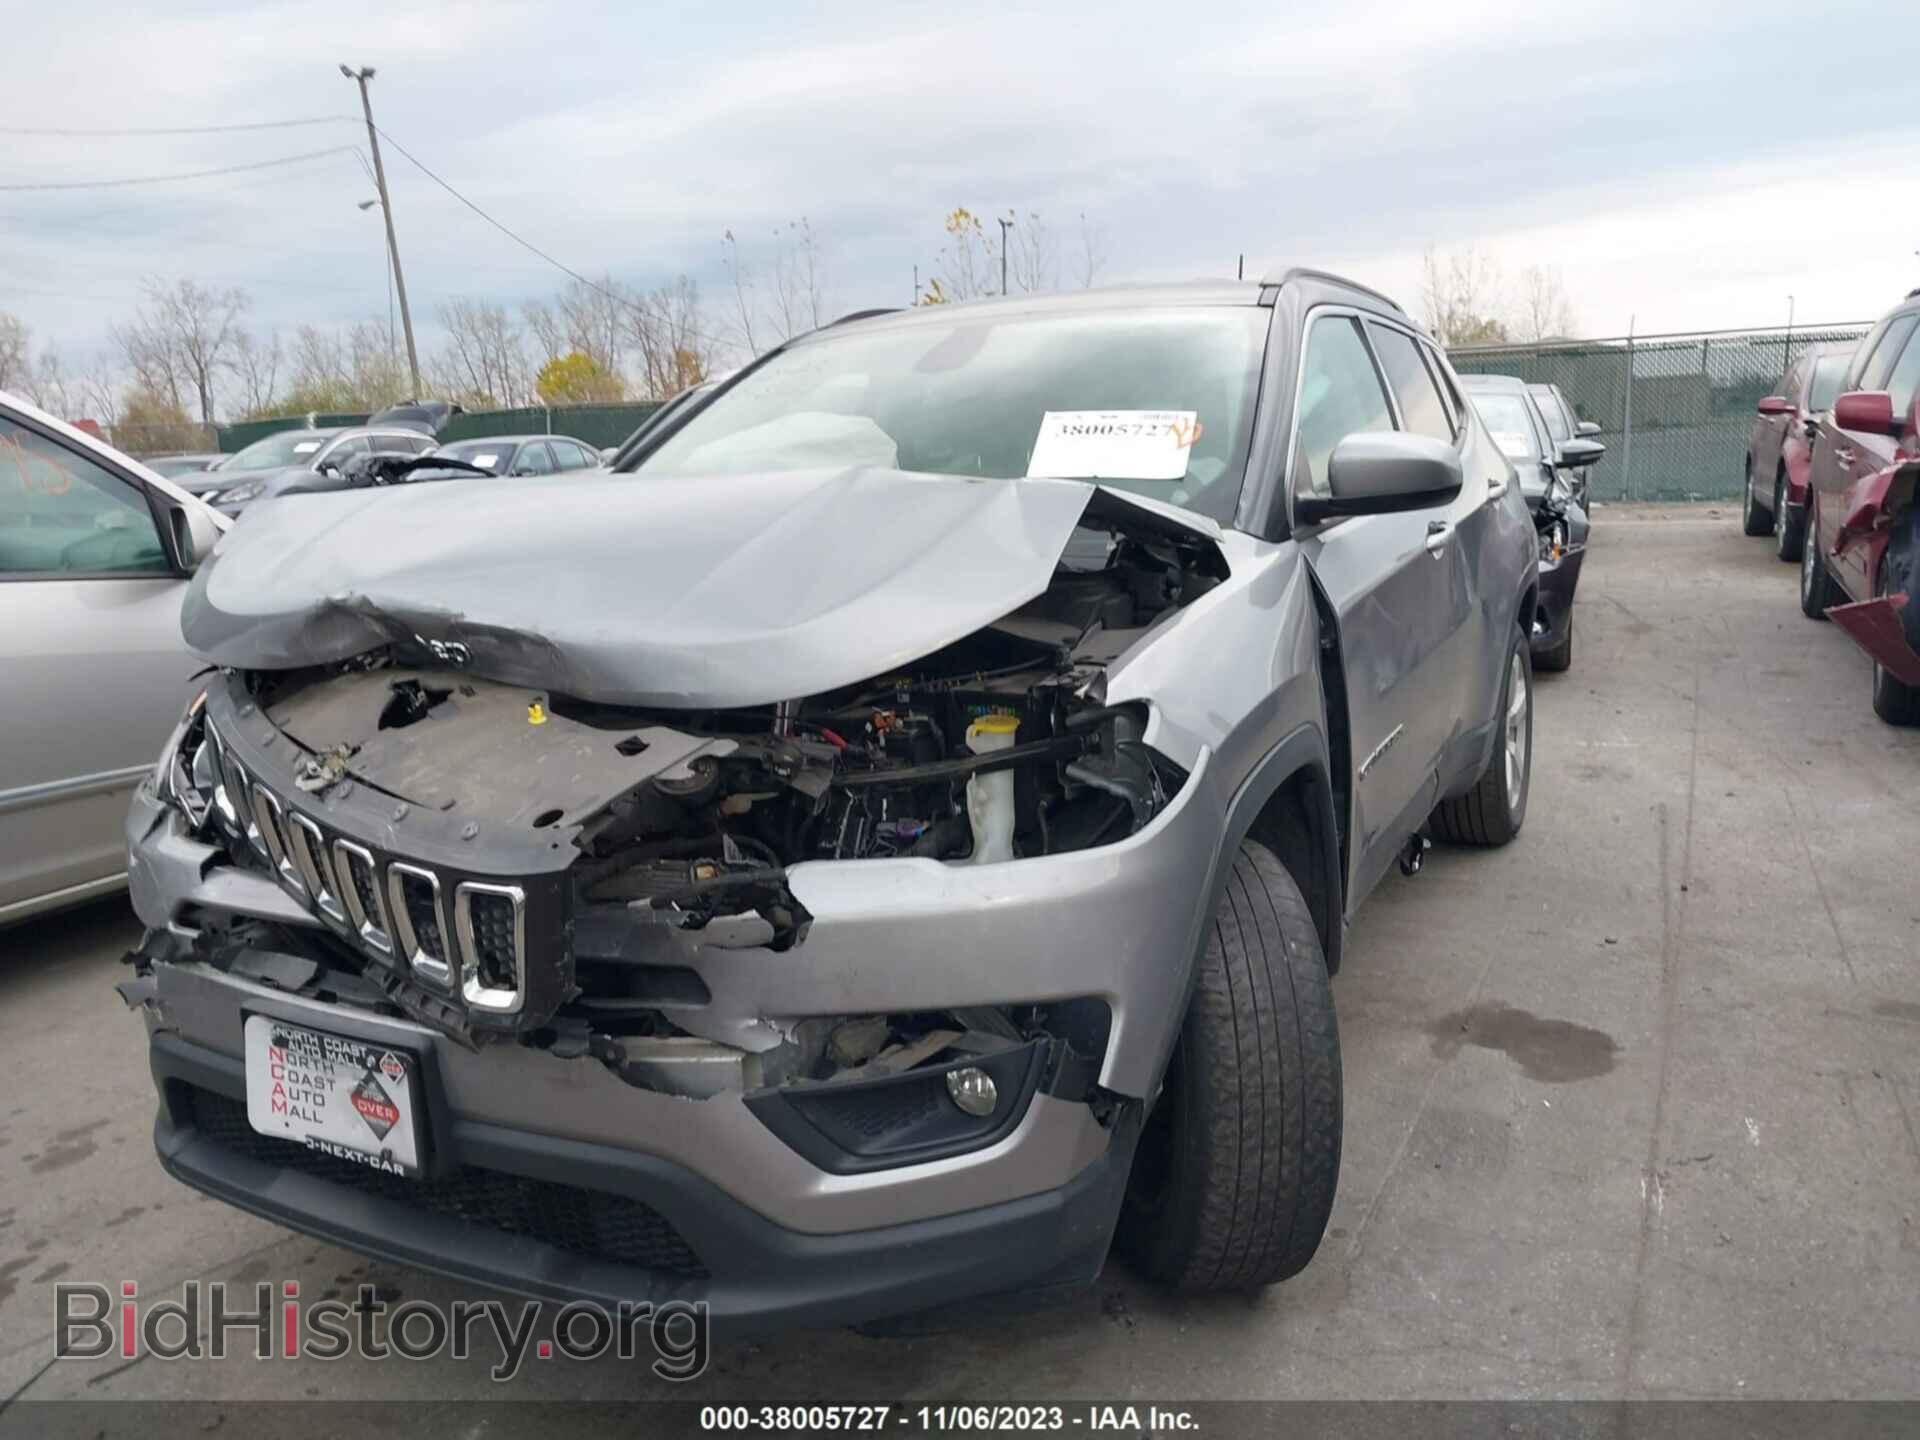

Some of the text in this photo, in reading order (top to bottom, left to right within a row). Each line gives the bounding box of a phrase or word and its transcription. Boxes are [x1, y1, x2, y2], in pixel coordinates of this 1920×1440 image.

[324, 1037, 367, 1059] COAST
[270, 1064, 336, 1092] COAST
[271, 1082, 326, 1107] AUTO
[271, 1097, 324, 1124] MALL
[357, 1099, 395, 1120] OVER
